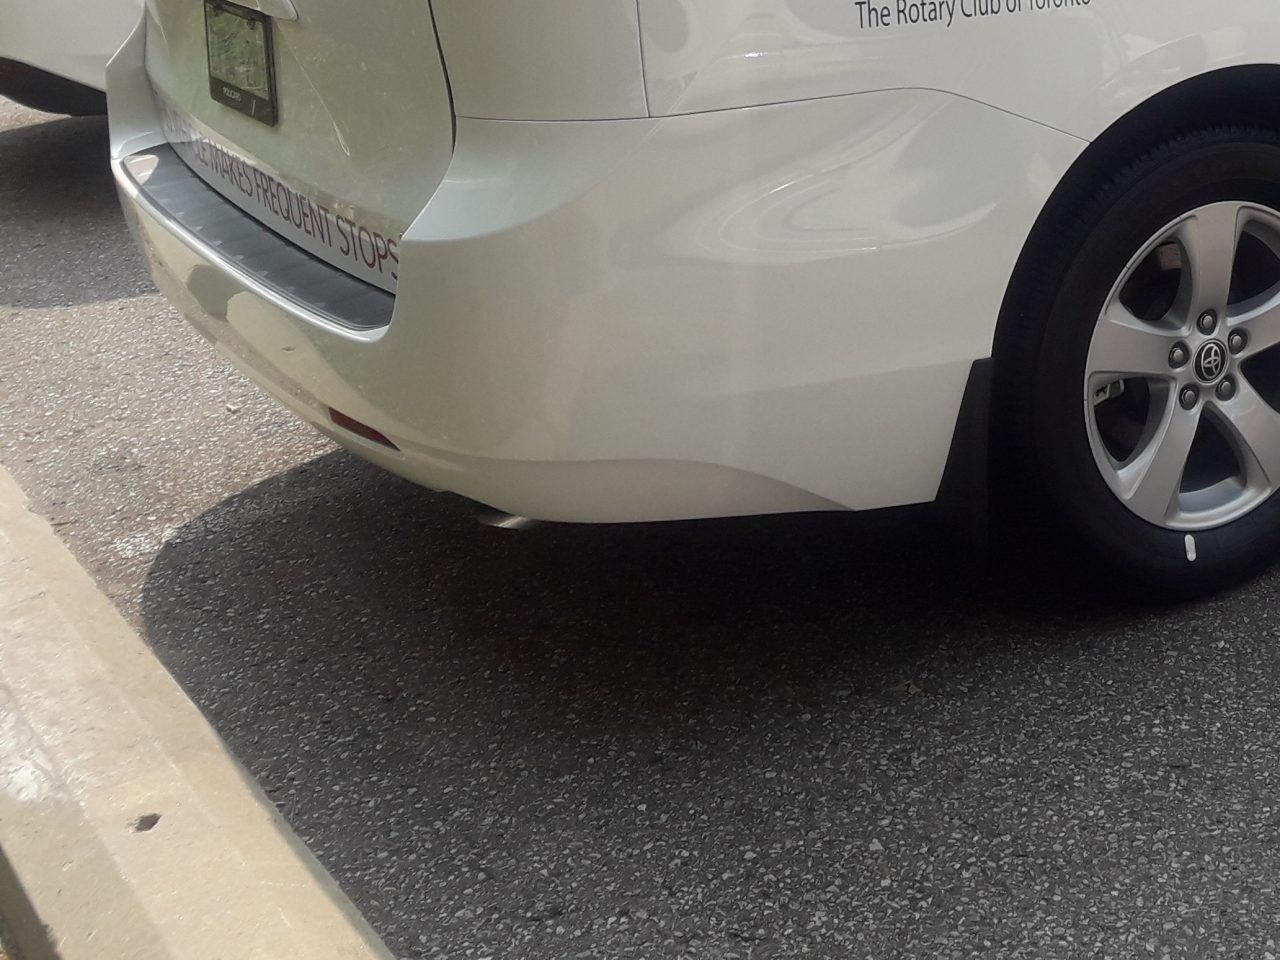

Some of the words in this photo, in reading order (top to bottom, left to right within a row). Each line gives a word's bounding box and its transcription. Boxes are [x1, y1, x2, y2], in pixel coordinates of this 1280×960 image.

[855, 0, 891, 29] The
[209, 143, 253, 197] MAKES
[253, 166, 332, 248] FREQUENT
[336, 214, 399, 281] STOPS
